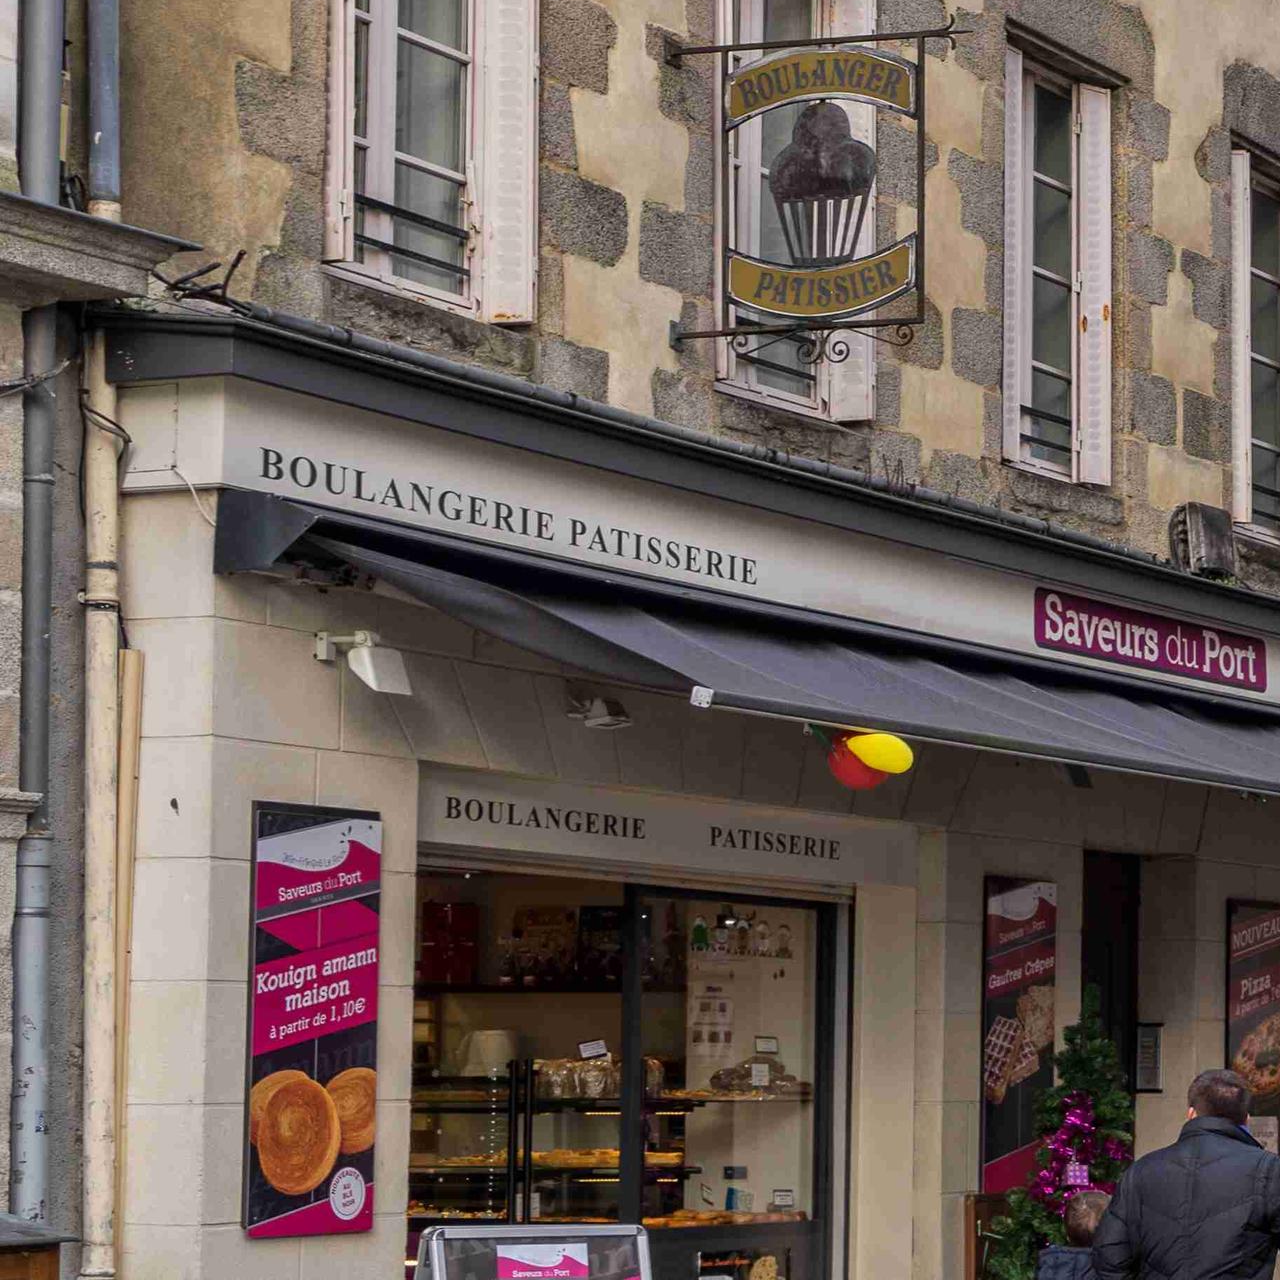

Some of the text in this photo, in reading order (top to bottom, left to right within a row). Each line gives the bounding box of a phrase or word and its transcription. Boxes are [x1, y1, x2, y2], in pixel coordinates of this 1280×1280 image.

[738, 58, 902, 110] BOULANGER
[754, 259, 897, 308] PATISSIER
[259, 446, 758, 586] BOULANGERIE PATISSERIE
[1044, 592, 1257, 683] Saveurs du Port
[445, 795, 842, 861] BOULANGERIE PATISSERIE
[278, 870, 363, 903] Saveurs du Port
[256, 946, 378, 995] Kouign amann
[284, 978, 350, 1012] maison
[1240, 974, 1271, 1000] Pizza
[268, 1024, 278, 1040] à
[279, 1016, 315, 1039] partir
[313, 1012, 327, 1027] de
